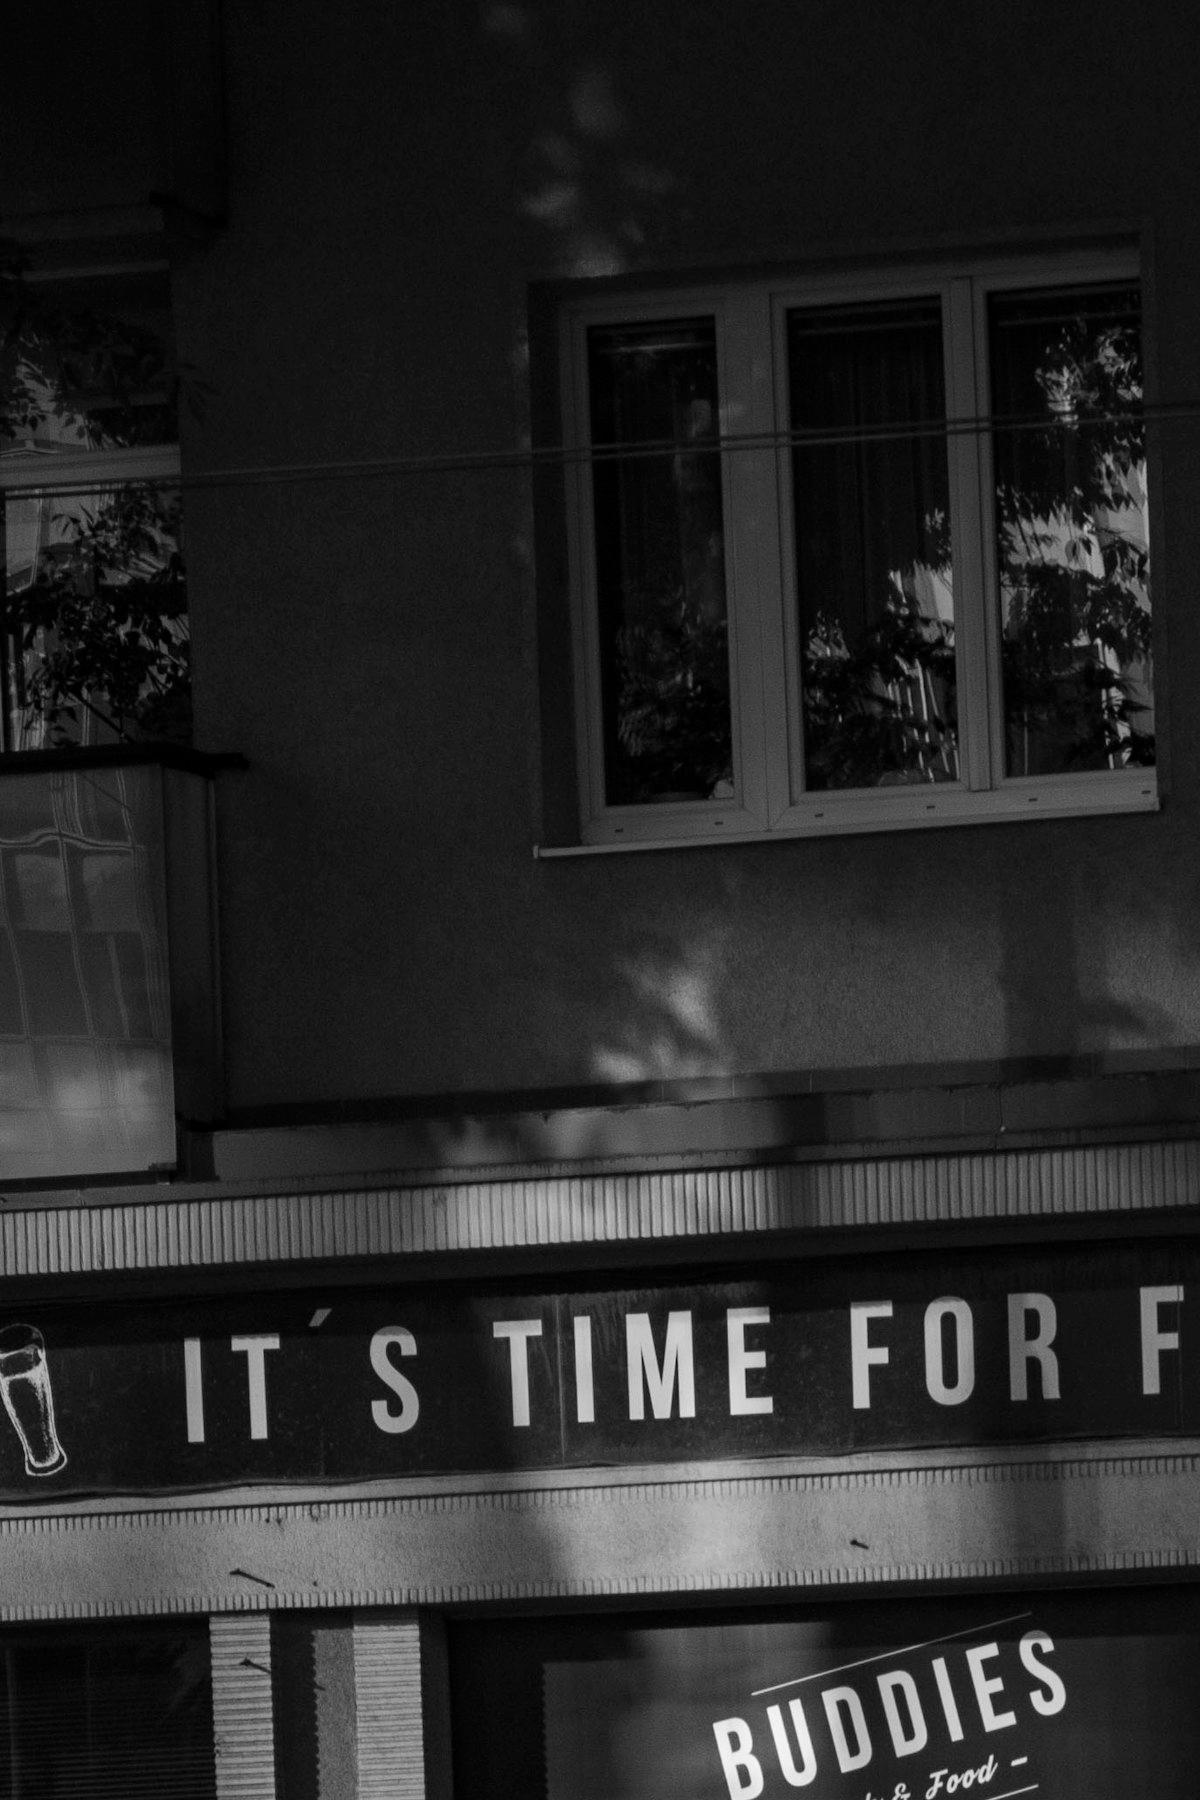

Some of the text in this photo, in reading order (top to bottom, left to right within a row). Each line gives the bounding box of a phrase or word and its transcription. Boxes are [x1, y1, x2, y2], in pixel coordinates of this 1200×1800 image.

[492, 1306, 774, 1428] TIME
[850, 1292, 1062, 1410] FOR
[924, 1753, 999, 1800] Food
